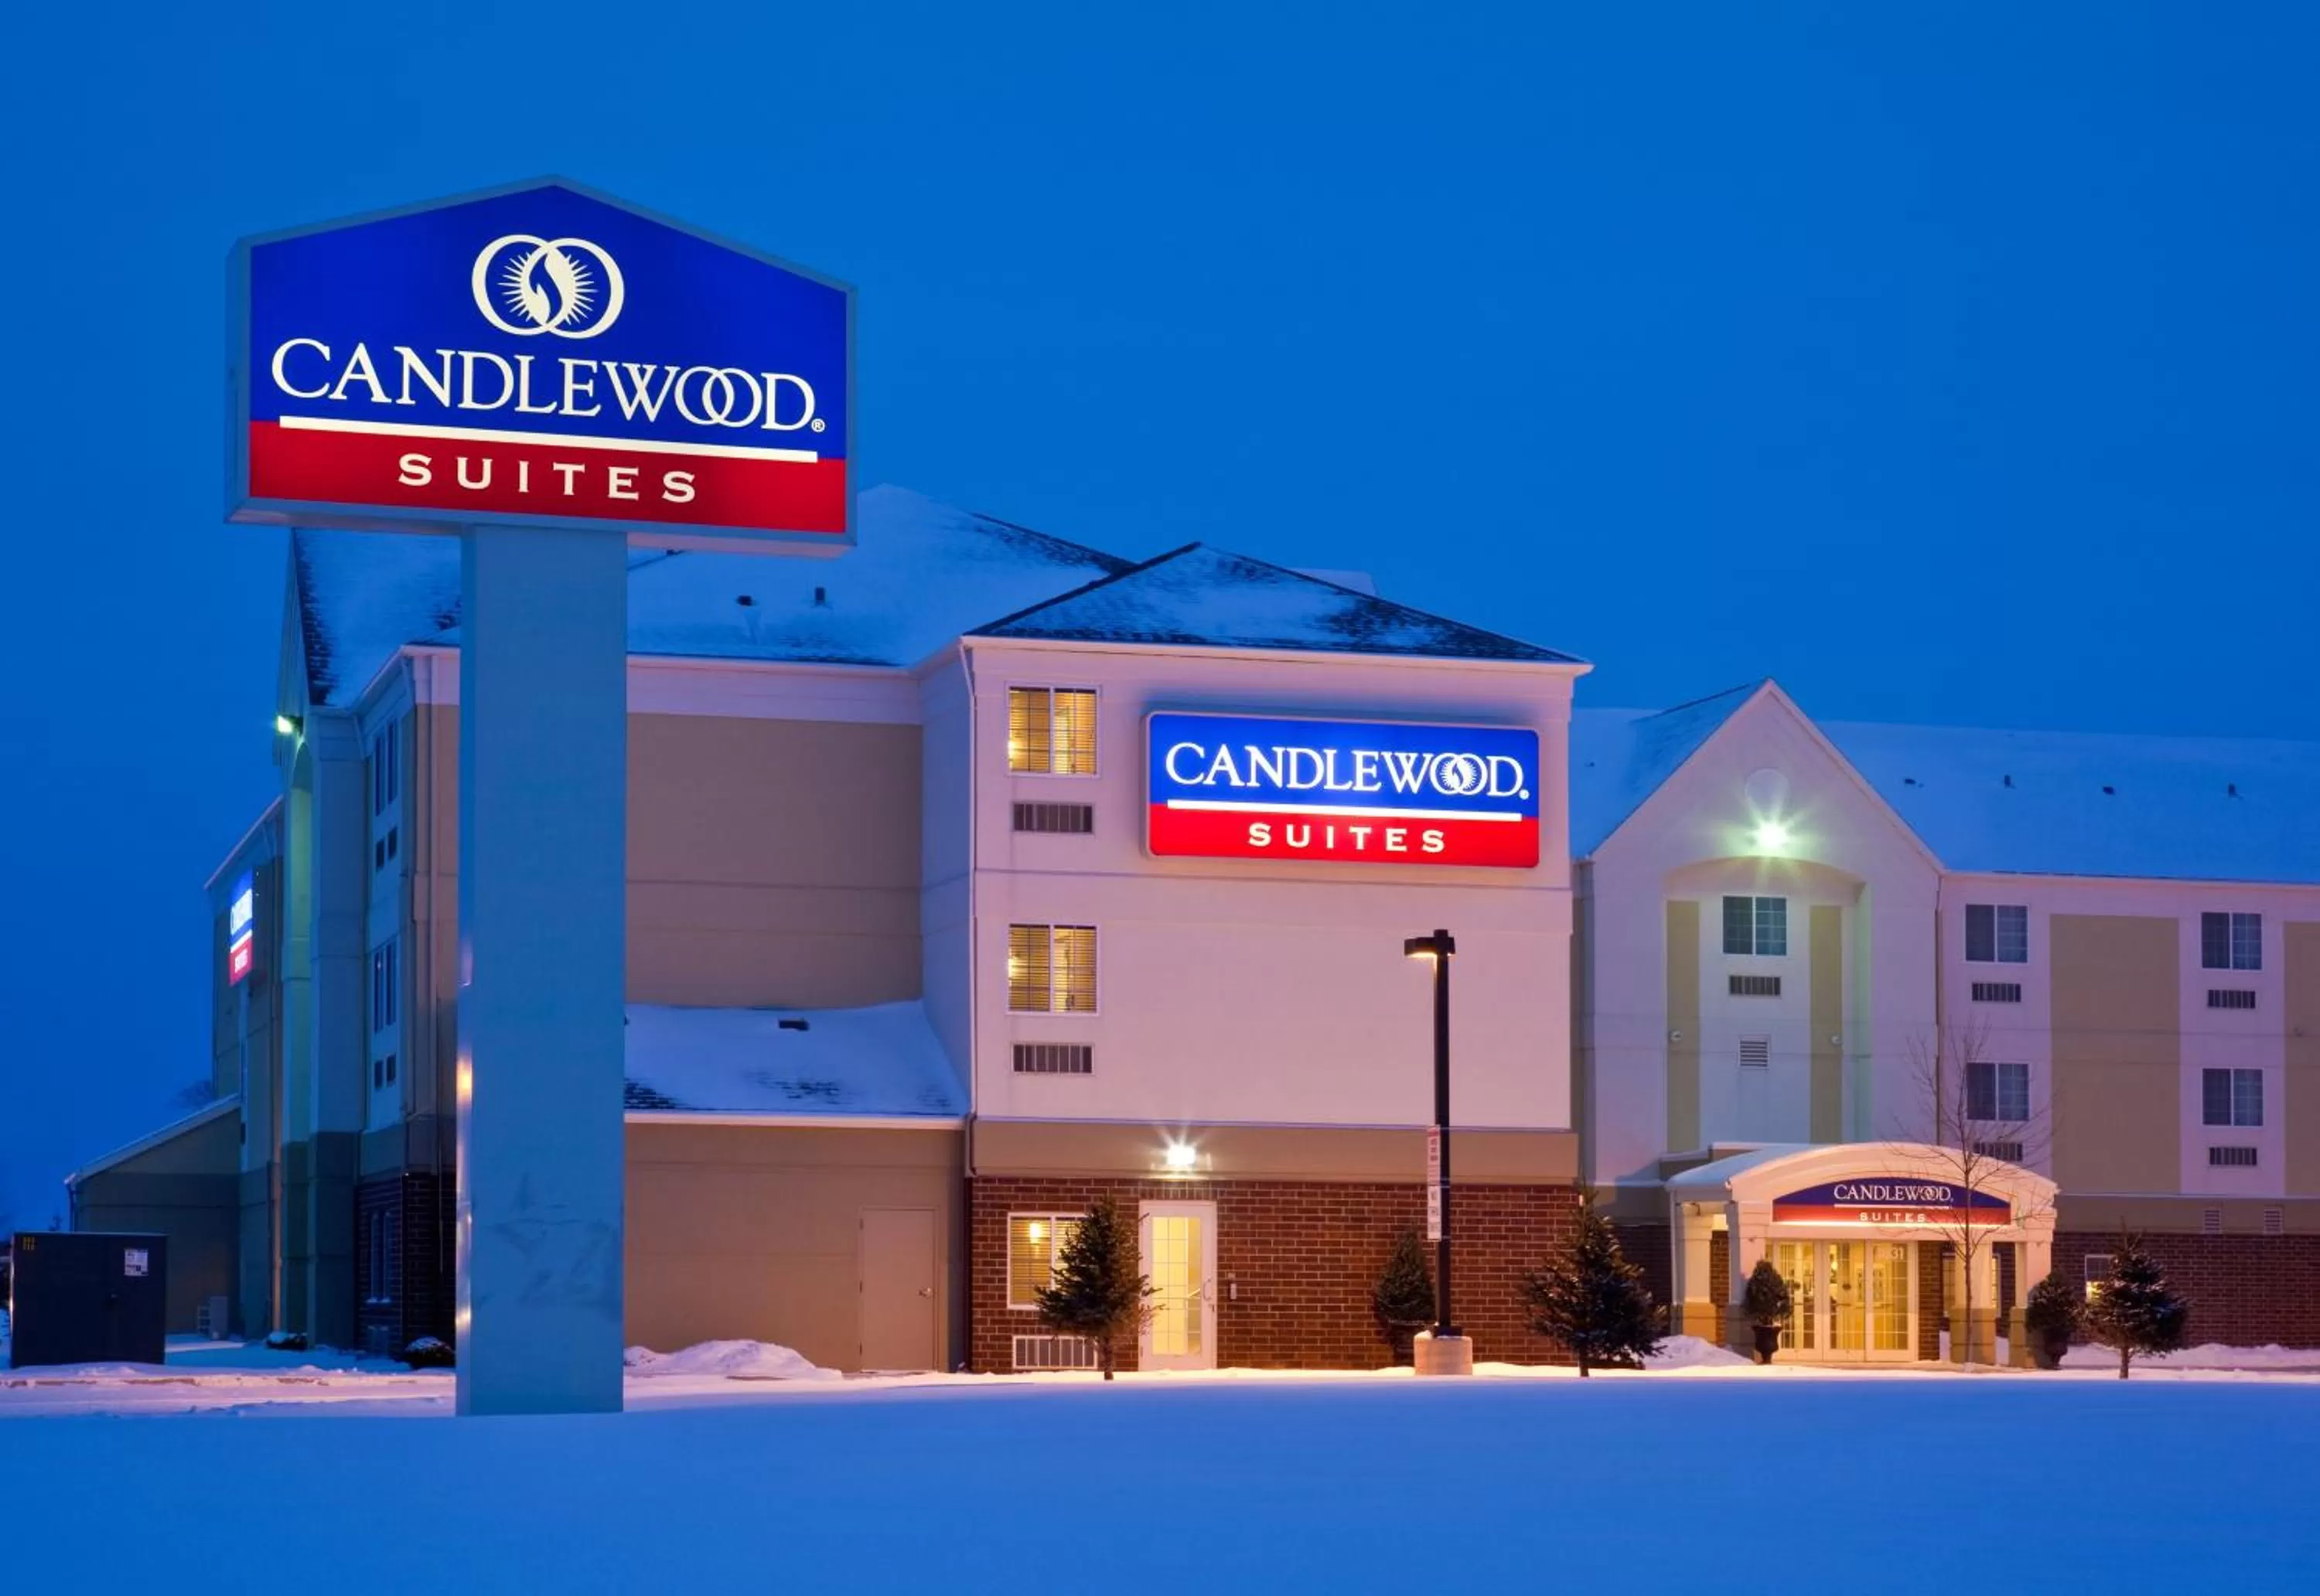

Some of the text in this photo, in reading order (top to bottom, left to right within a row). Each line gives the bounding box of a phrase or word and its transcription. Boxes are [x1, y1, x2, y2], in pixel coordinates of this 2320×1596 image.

[398, 453, 695, 503] SUITES
[1165, 742, 1524, 798] CANDLEWOOD
[1248, 822, 1445, 853] SUITES
[1834, 1184, 1952, 1201] CANDLEWOOD
[1859, 1212, 1926, 1223] SUITES
